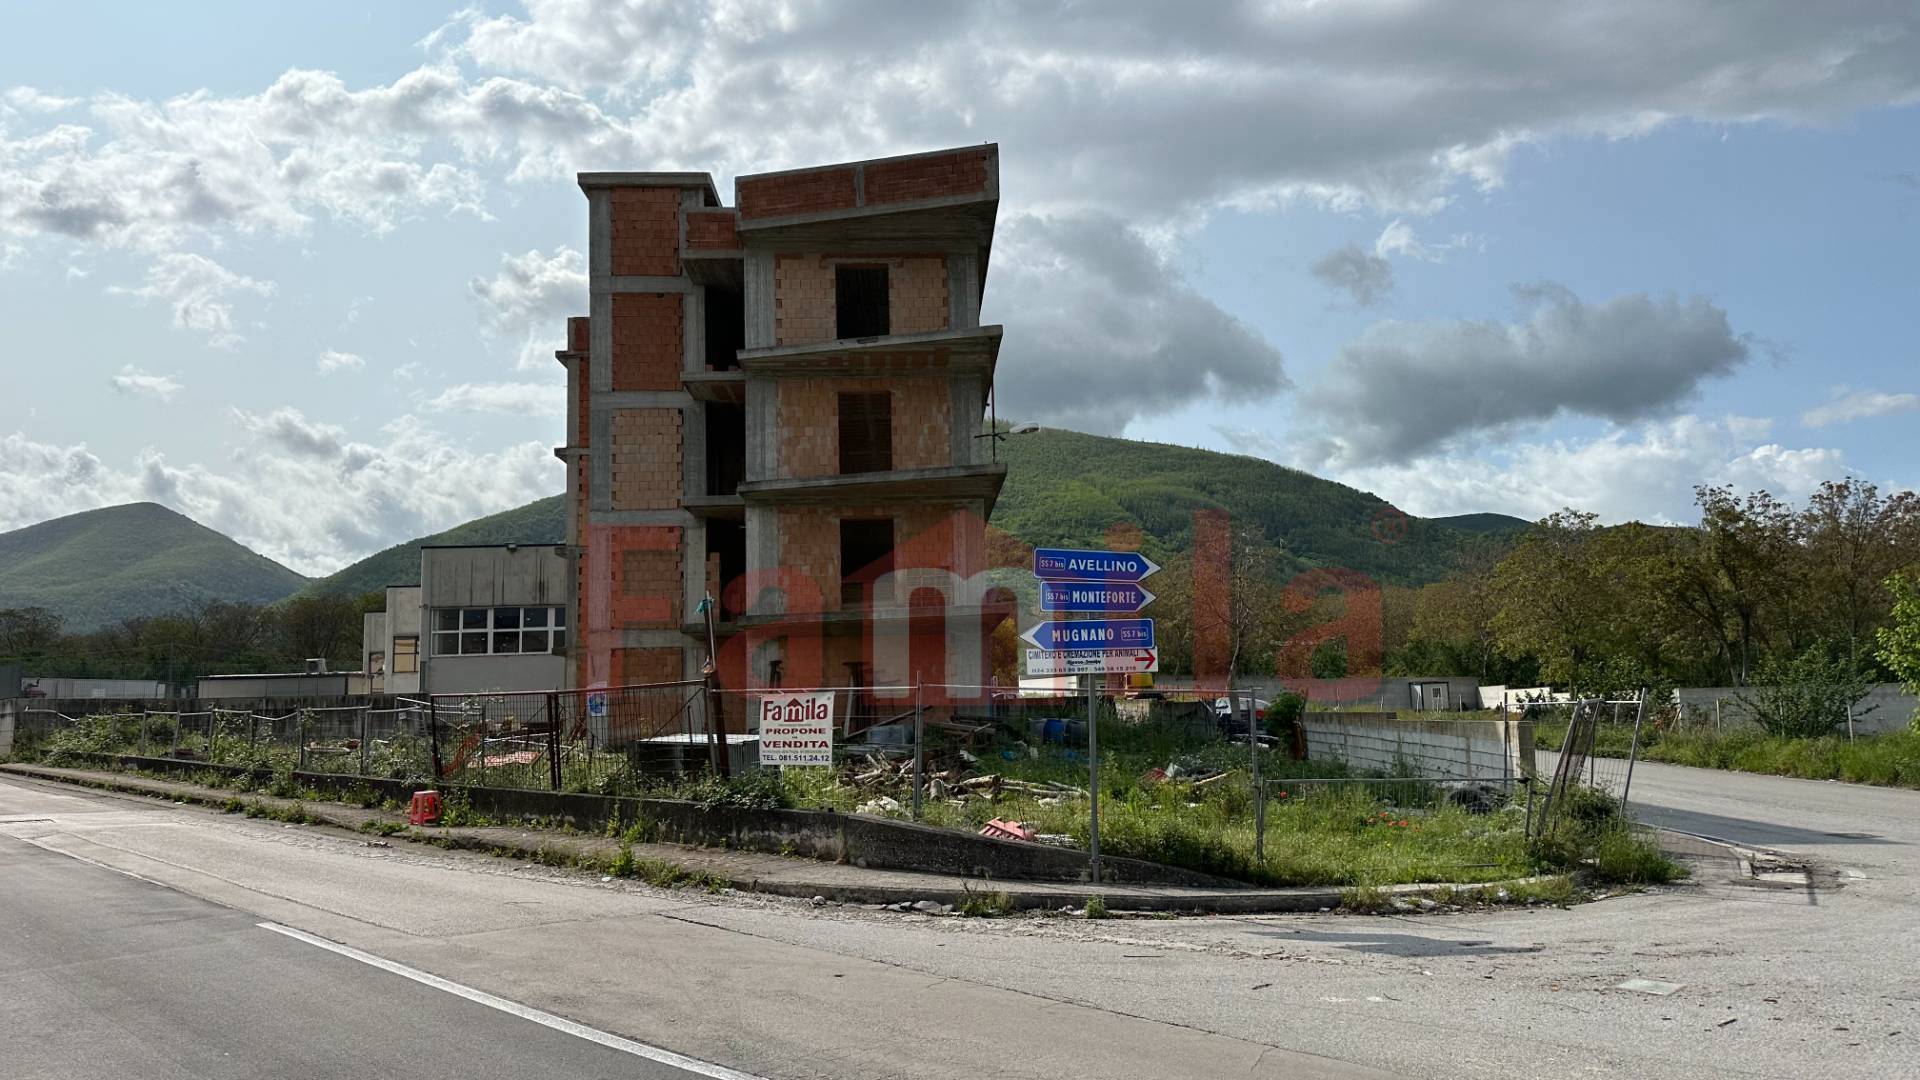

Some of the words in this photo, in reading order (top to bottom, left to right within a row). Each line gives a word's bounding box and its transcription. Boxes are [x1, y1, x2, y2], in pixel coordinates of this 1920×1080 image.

[1068, 559, 1137, 573] AVELLINO
[1072, 590, 1137, 603] MONTEFORTE
[1052, 628, 1114, 642] MUGNANO
[1028, 650, 1056, 660] CIMITERO
[1064, 650, 1101, 659] CREMAZIONE
[1102, 649, 1114, 658] PER
[1114, 648, 1139, 658] ANIMALI
[763, 697, 828, 722] Famila
[762, 740, 829, 748] VENDITA
